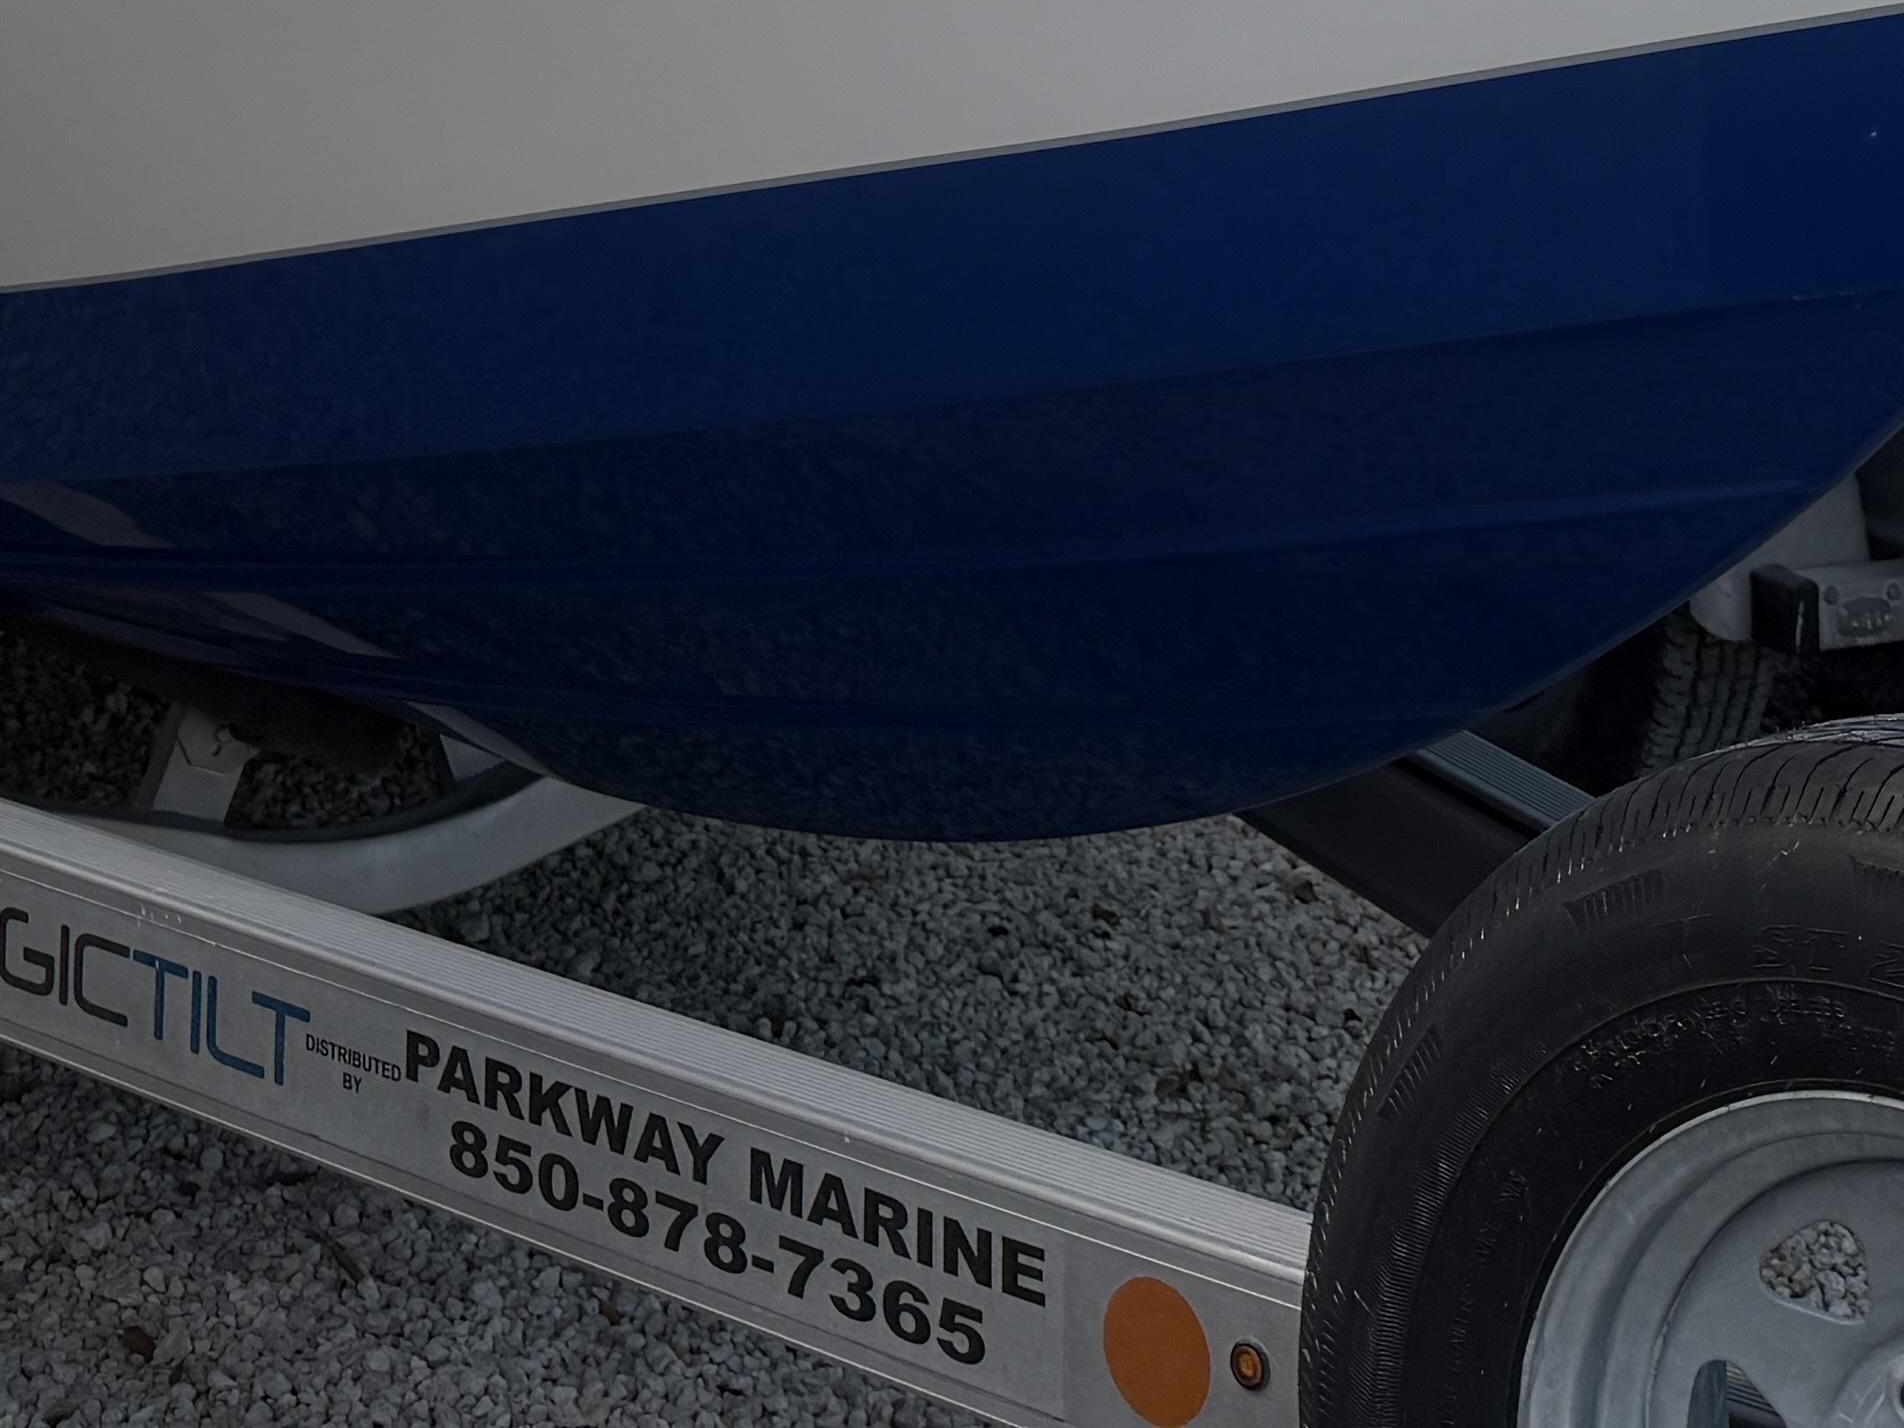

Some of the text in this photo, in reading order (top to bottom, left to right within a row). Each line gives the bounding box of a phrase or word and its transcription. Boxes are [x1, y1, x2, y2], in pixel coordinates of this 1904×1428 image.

[1752, 924, 1848, 972] ST
[305, 1032, 402, 1082] DISTRIBUTED
[343, 1072, 362, 1093] BY
[405, 1030, 1048, 1308] PARKWAY MARINE
[448, 1120, 989, 1366] 850-878-7365
